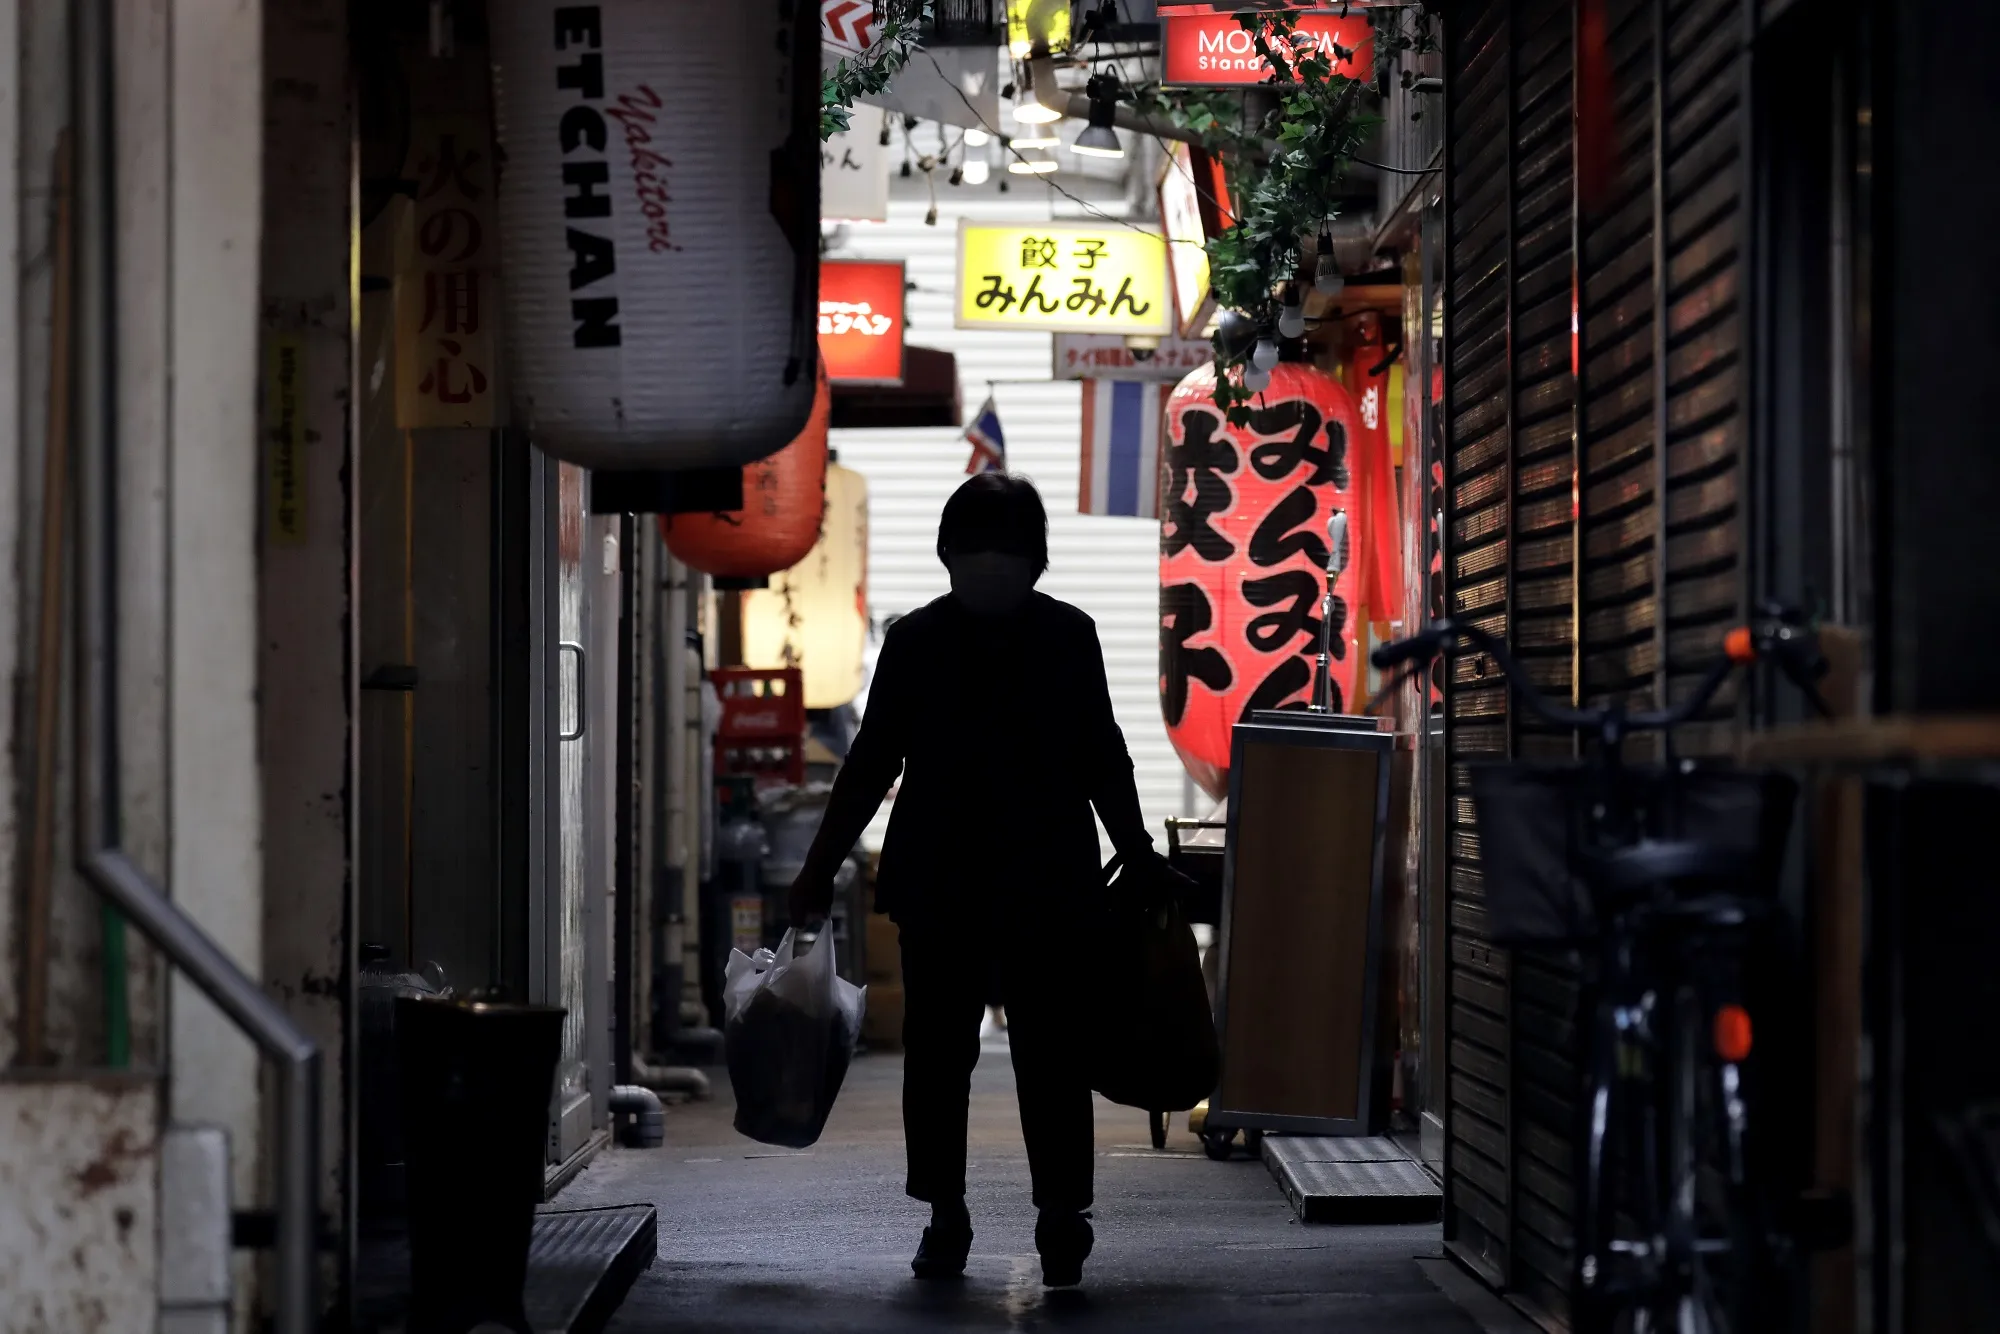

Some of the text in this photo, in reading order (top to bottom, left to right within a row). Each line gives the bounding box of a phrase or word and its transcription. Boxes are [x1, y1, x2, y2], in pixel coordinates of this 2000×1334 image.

[554, 5, 621, 347] ETCHAN
[606, 84, 682, 253] Yakitori
[1021, 237, 1108, 269] 餃子
[418, 134, 487, 405] 火の用心
[975, 275, 1150, 316] みんみん
